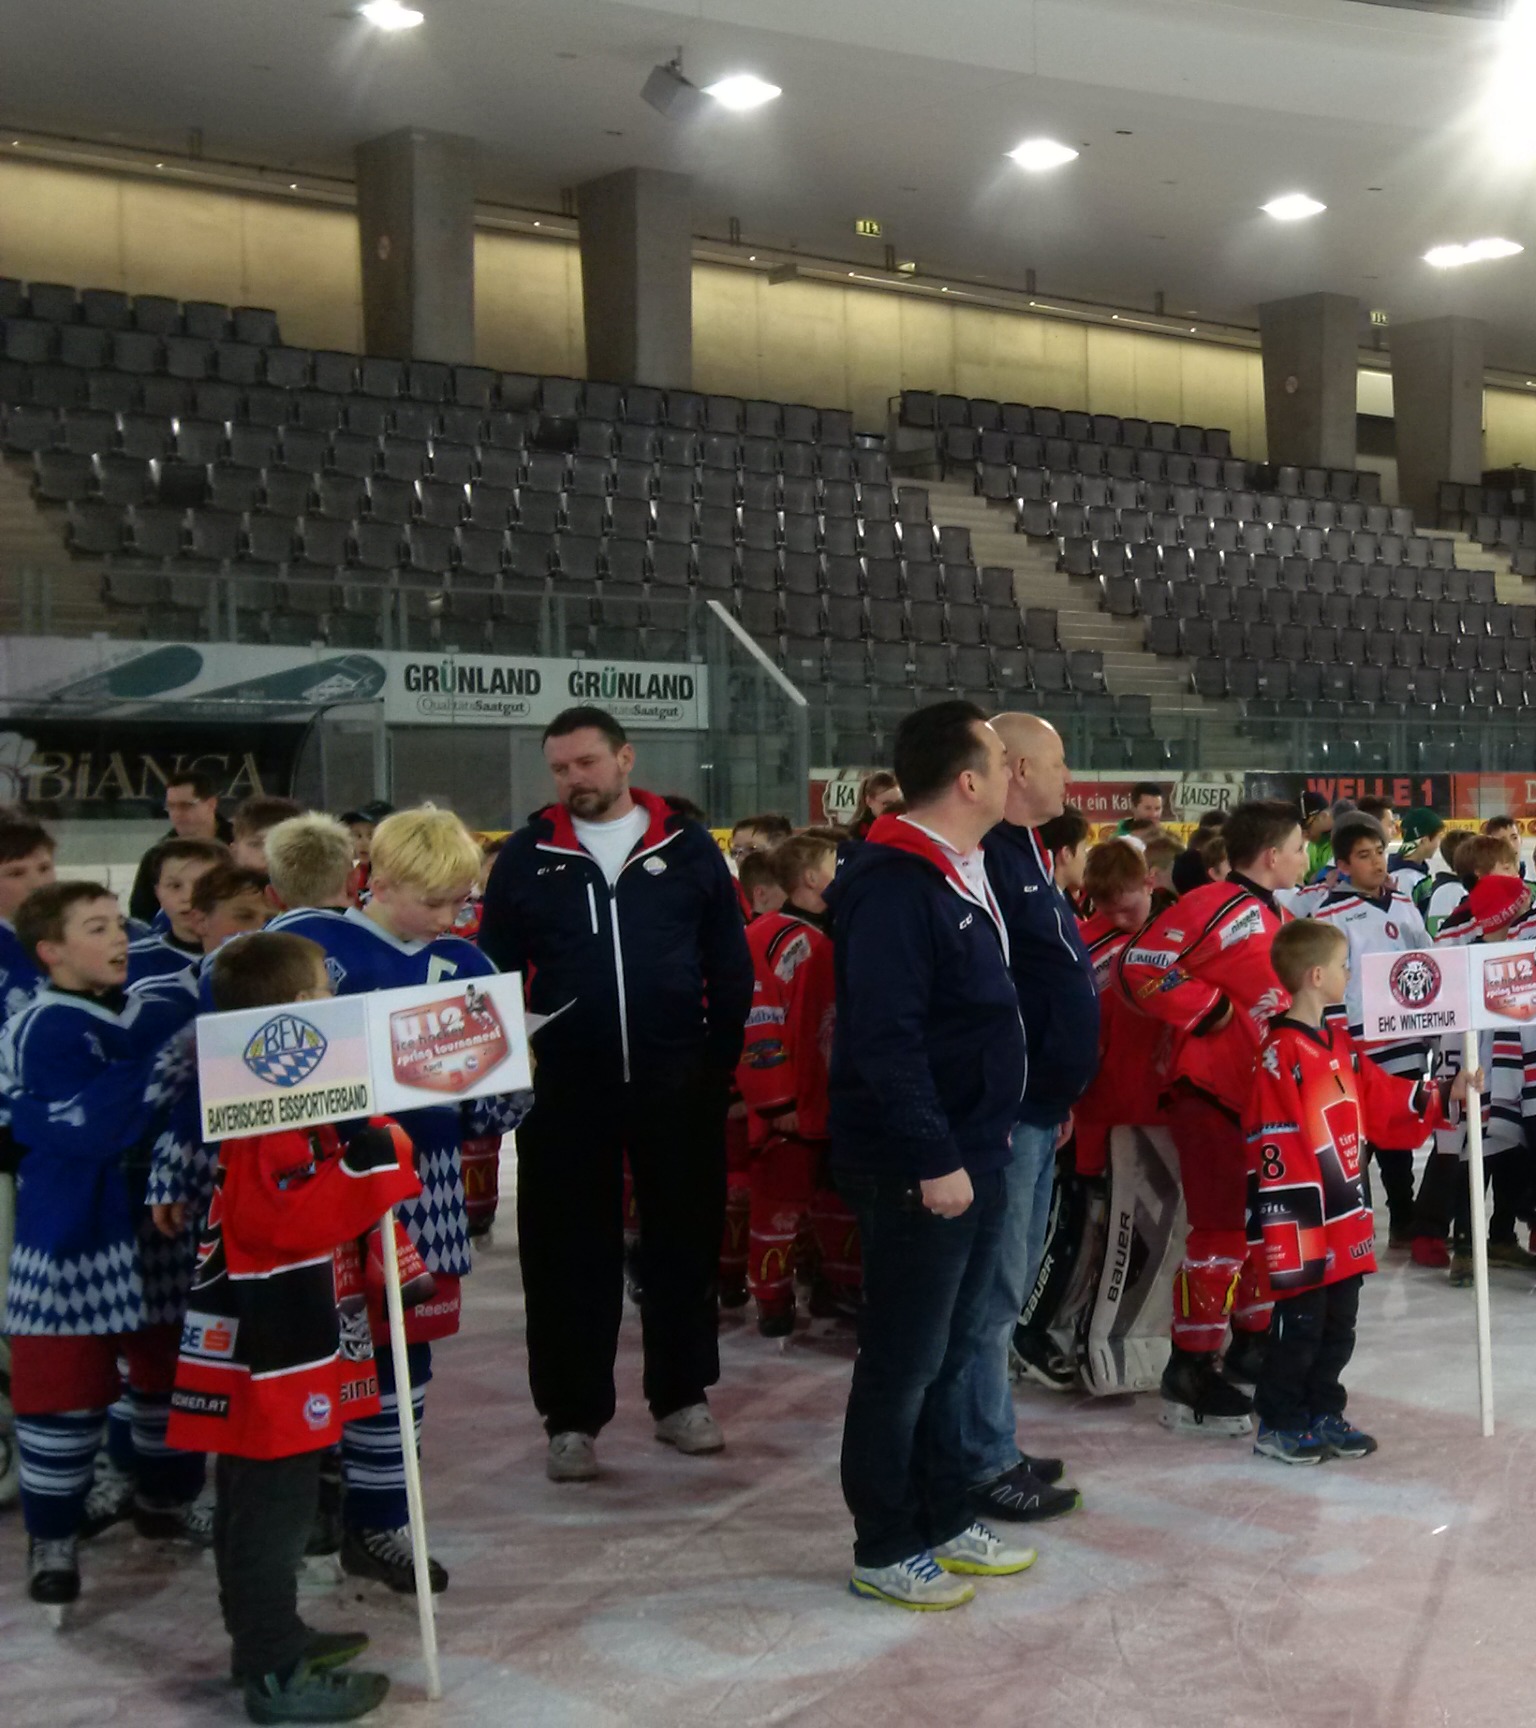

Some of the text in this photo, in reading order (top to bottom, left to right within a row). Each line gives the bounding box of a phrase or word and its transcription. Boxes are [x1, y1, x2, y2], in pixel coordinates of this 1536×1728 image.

[404, 660, 541, 695] GRÜNLAND
[568, 667, 694, 700] GRÜNLAND
[1087, 794, 1108, 811] ein
[1180, 788, 1231, 809] KAISER
[1485, 959, 1534, 981] U12
[264, 1019, 306, 1054] BEV
[395, 1006, 465, 1043] U12
[1378, 1011, 1456, 1033] EHC WINTERTHUR
[397, 1024, 501, 1067] spring tournament
[207, 1084, 368, 1134] BAYERISCHER EISSPORTVERBAND
[1107, 1211, 1132, 1303] BAUER
[414, 1299, 460, 1318] Reebok
